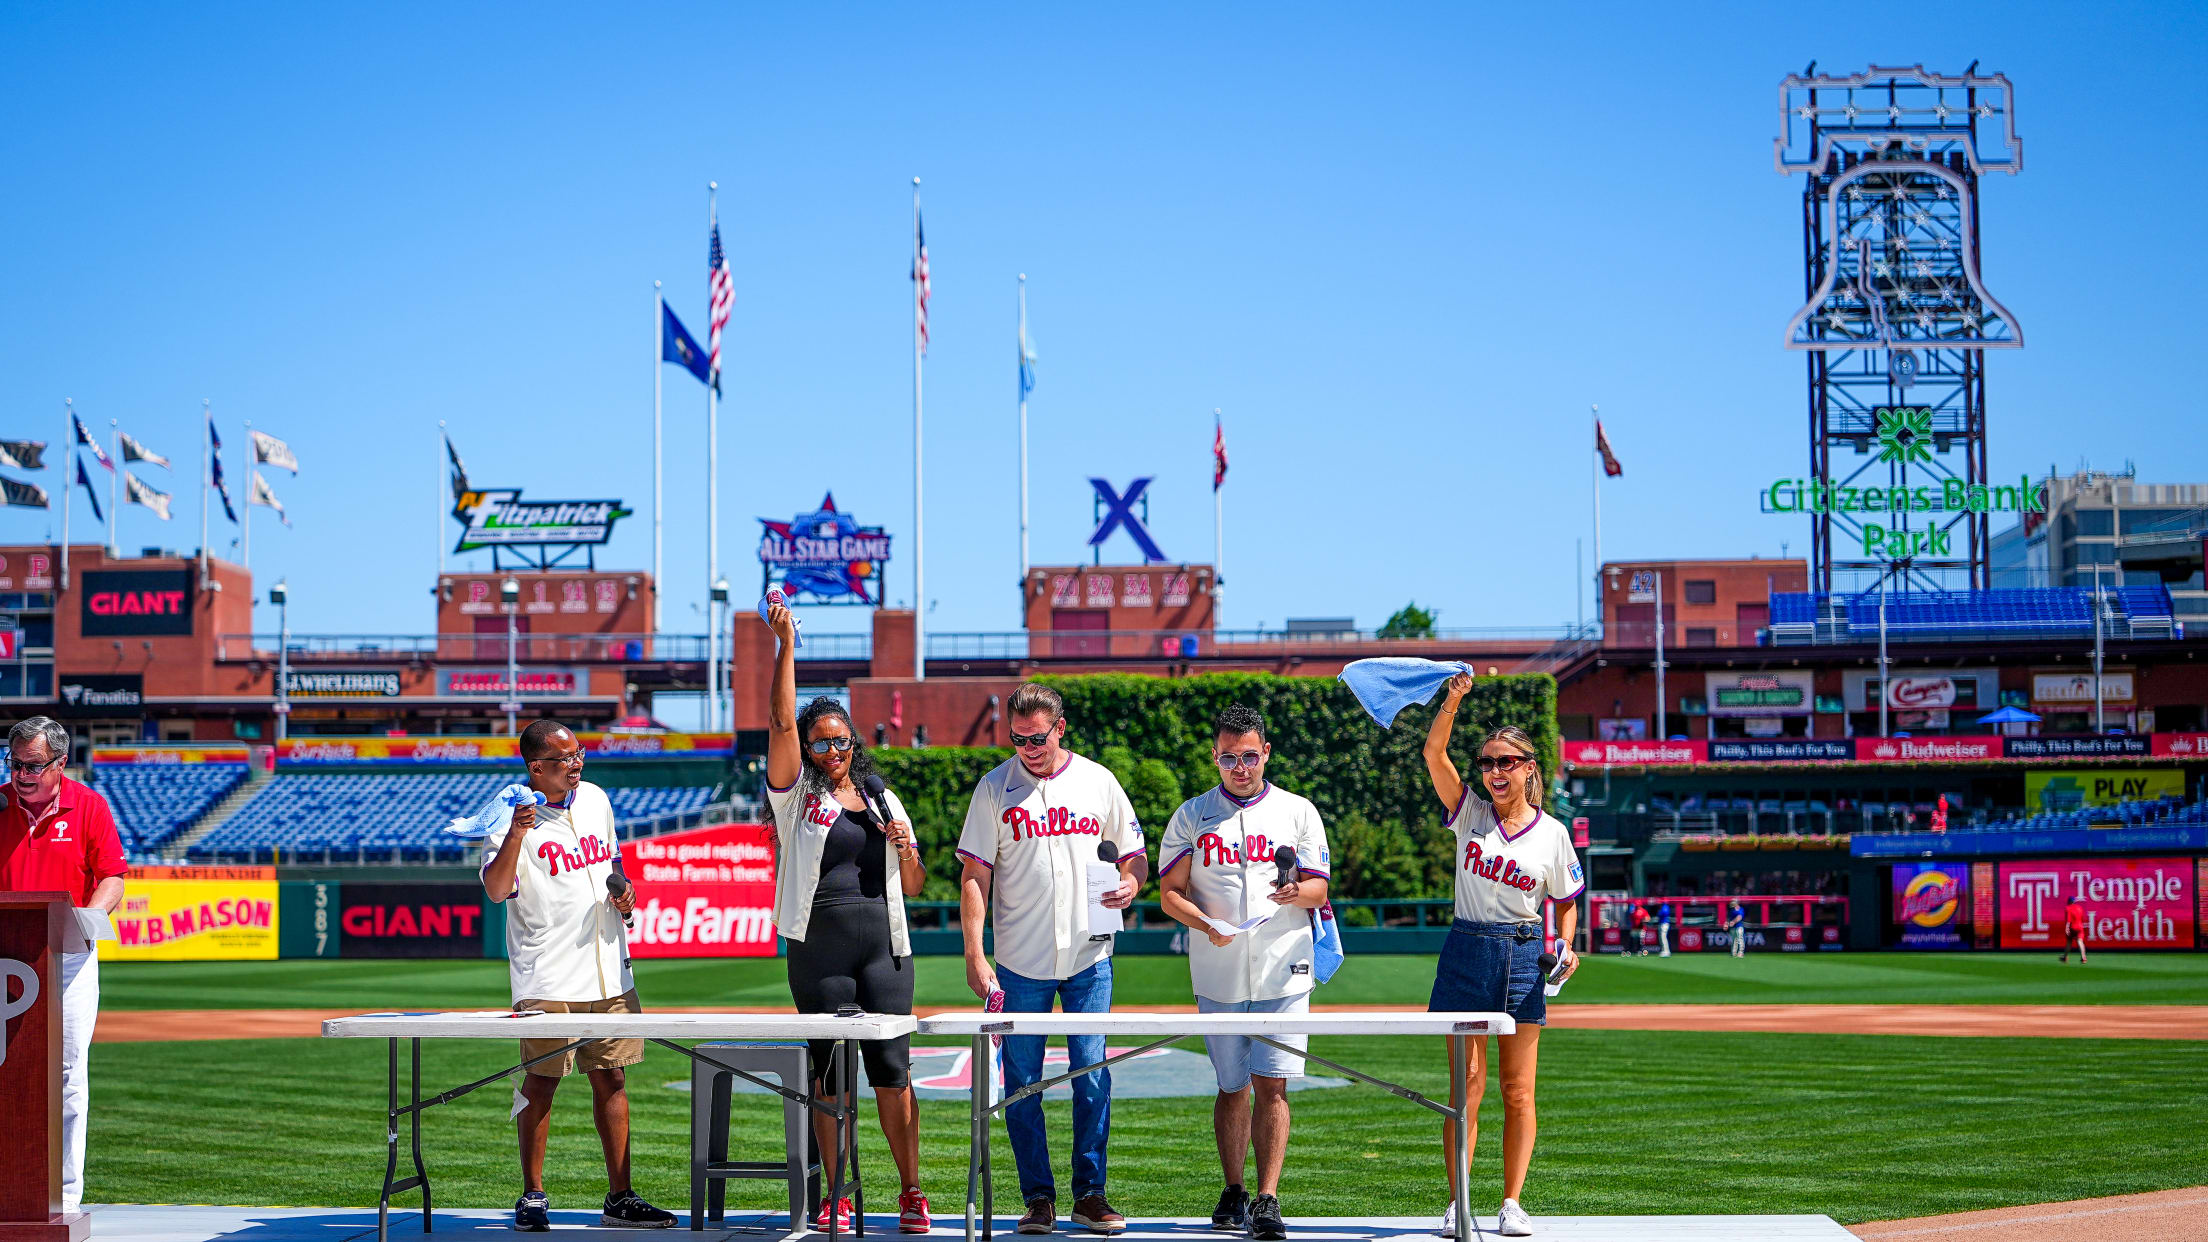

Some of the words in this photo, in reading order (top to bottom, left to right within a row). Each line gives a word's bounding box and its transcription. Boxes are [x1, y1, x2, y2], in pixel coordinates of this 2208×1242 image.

[1768, 477, 1931, 512] Citizens
[1942, 473, 2045, 512] Bank
[466, 491, 609, 527] Fitzpatrick
[795, 535, 840, 562] STAR
[840, 535, 890, 562] GAME
[1863, 520, 1949, 557] Park
[28, 554, 50, 578] P
[468, 581, 490, 602] P
[1087, 574, 1114, 597] 32
[1123, 573, 1151, 596] 34
[1629, 571, 1655, 593] 42
[90, 591, 185, 615] GIANT
[82, 688, 141, 705] Fanatics
[1605, 744, 1693, 762] Budweiser
[1806, 743, 1824, 755] For
[1901, 741, 1988, 758] Budweiser
[2047, 740, 2071, 753] This
[2073, 740, 2101, 752] Bud's
[2104, 739, 2122, 752] For
[2123, 738, 2144, 751] You
[2094, 778, 2147, 798] PLAY
[801, 793, 839, 827] Phil
[54, 820, 68, 838] P
[1002, 806, 1100, 842] Phillies
[537, 834, 612, 877] Philli
[636, 842, 666, 860] Like
[667, 844, 677, 859] a
[677, 842, 711, 862] good
[712, 841, 772, 863] neighbor,
[1196, 832, 1297, 867] Philli
[643, 864, 681, 882] State
[682, 864, 719, 882] Farm
[719, 864, 732, 882] is
[1464, 840, 1537, 892] Phillies
[2070, 869, 2182, 911] Temple
[341, 905, 481, 937] GIANT
[627, 897, 773, 944] ateFarm
[1705, 932, 1766, 946] TOYTA
